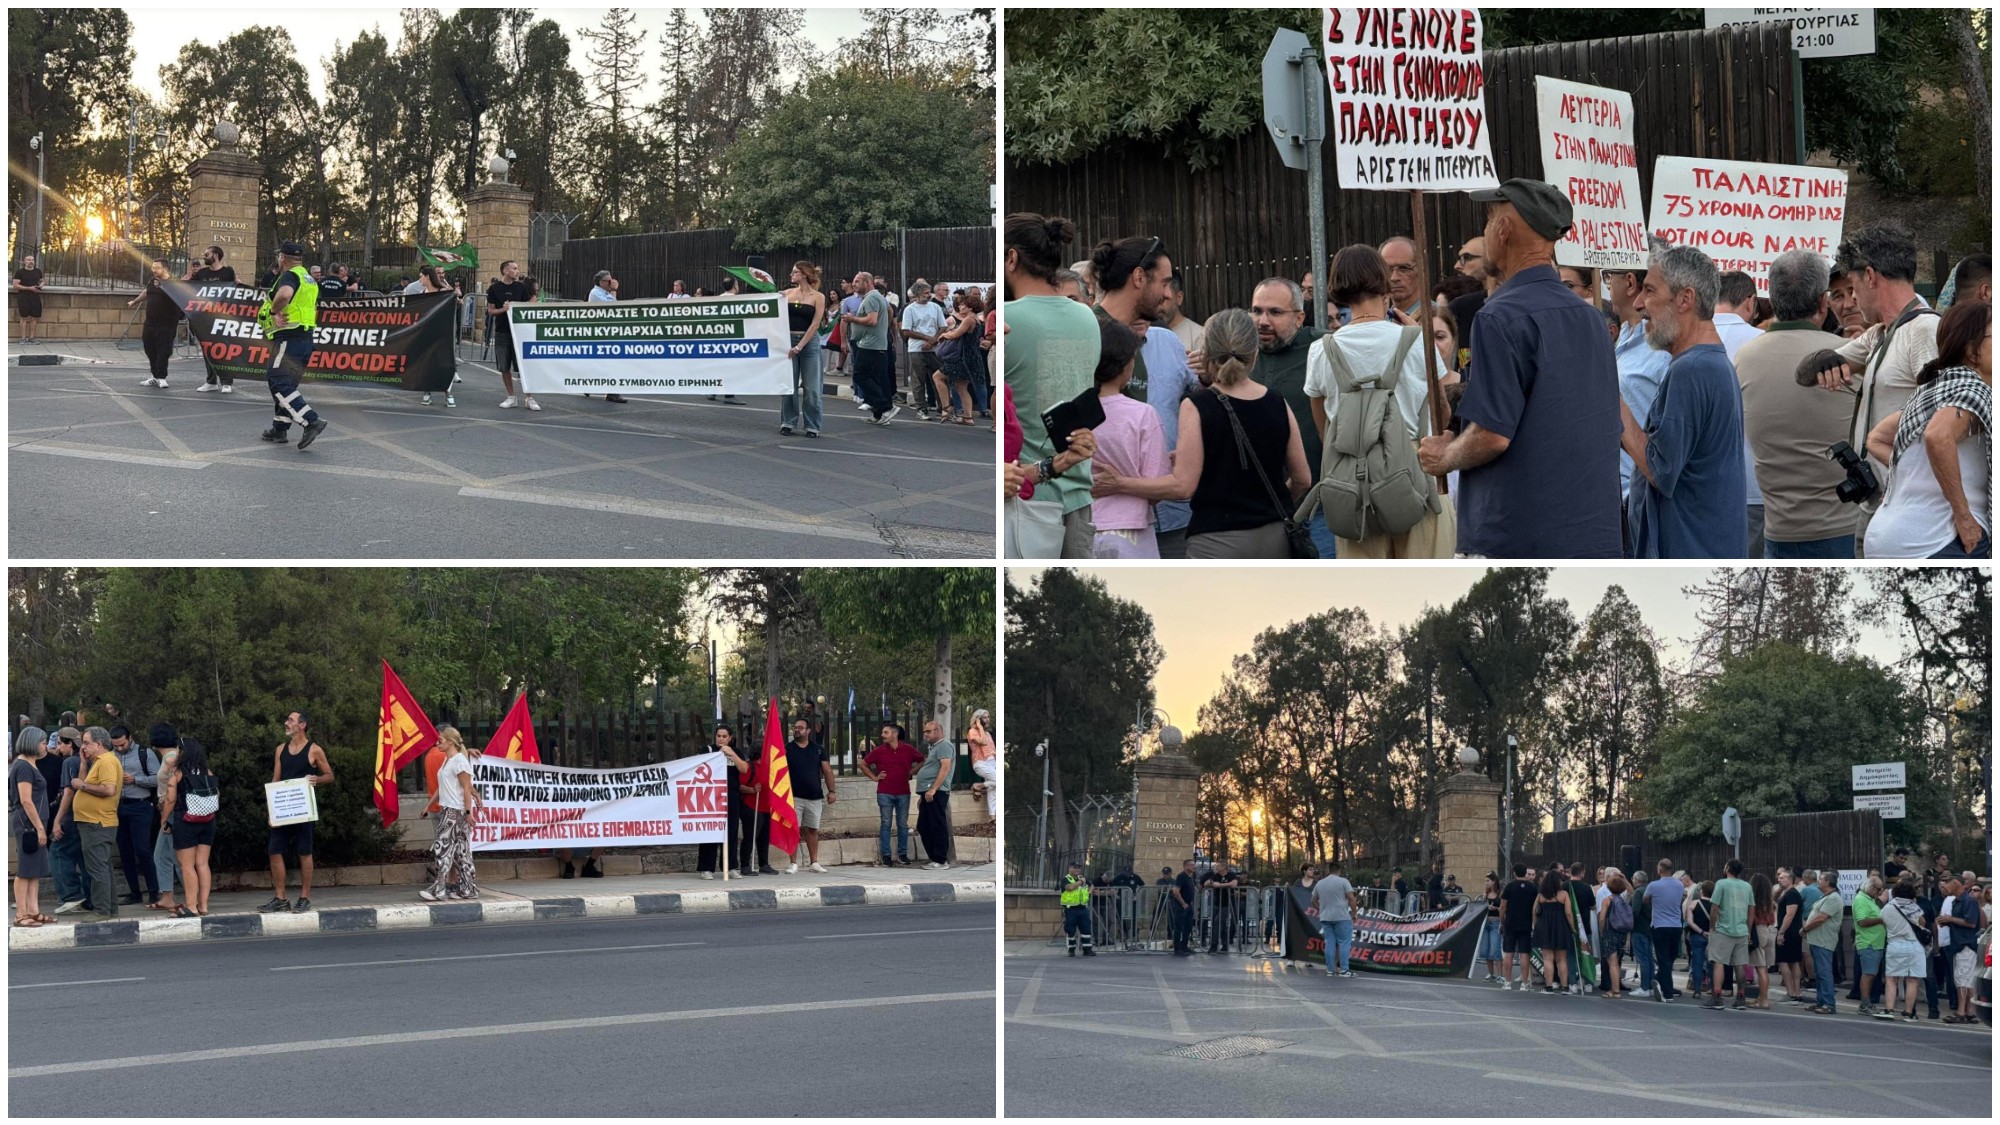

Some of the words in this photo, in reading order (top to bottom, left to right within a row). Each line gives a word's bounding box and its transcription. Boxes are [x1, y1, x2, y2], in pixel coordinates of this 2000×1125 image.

[1796, 34, 1834, 48] 21:00
[1330, 55, 1386, 95] ΣΤΗΝ
[1560, 93, 1622, 129] ΛΕΥΤΕΡΙΑ
[1340, 101, 1482, 149] ΠΑΡΑΙΤΗΣΟΥ
[1554, 132, 1587, 163] ΣΤΗΝ
[1357, 154, 1430, 184] ΑΡΙΣΤΕΡΗ
[1436, 154, 1495, 179] ΠΤΕΡΥΓΑ
[1569, 177, 1626, 209] FREEDOM
[1663, 194, 1694, 218] 75
[1698, 199, 1764, 220] ΧΡΟΝΙΑ
[1768, 204, 1842, 221] ΟΜΗΡΙΑΣ
[210, 220, 249, 230] ΕΙΣΟΔΟΣ
[1561, 221, 1580, 244] OR
[1581, 218, 1648, 252] PALESTINE
[1689, 229, 1709, 247] IN
[1711, 229, 1754, 249] OUR
[196, 286, 268, 301] ΛΕΥΤΕΡΙΑ
[317, 297, 405, 309] ΑΛΑΙΣΤΙΝΗ!
[184, 300, 259, 317] ΣΤΑΜΑΤΗ
[321, 310, 419, 326] ΓΕΝΟΚΤΟΝΙΑ!
[520, 308, 638, 319] ΥΠΕΡΑΣΠΙΖΟΜΑΣΤΕ
[641, 307, 659, 317] ΤΟ
[660, 305, 719, 317] ΔΙΕΘΝΕΣ
[720, 303, 769, 315] ΔΙΚΑΙΟ
[210, 318, 264, 340] FREE
[312, 327, 388, 347] ESTINE!
[544, 327, 565, 337] ΚΑΙ
[566, 327, 592, 336] ΤΗΝ
[594, 325, 664, 336] ΚΥΡΙΑΡΧΙΑ
[665, 325, 693, 335] ΤΩΝ
[695, 324, 735, 335] ΛΑΩΝ
[200, 341, 242, 361] TOP
[248, 346, 271, 364] TH
[307, 351, 407, 373] ENOCIDE!
[529, 345, 593, 355] ΑΠΕΝΑΝΤΙ
[596, 345, 621, 355] ΣΤΟ
[624, 345, 665, 355] ΝΟΜΟ
[668, 344, 695, 354] ΤΟΥ
[698, 343, 759, 354] ΙΣΧΥΡΟΥ
[564, 378, 617, 386] ΠΑΓΚΥΠΡΙΟ
[619, 378, 675, 387] ΣΥΜΒΟΥΛΙΟ
[678, 379, 723, 387] ΕΙΡΗΝΗΣ
[473, 764, 513, 783] ΚΑΜΙΑ
[514, 768, 560, 785] ΣΤΗΡΙΞΗ
[561, 773, 599, 785] ΚΑΜΙΑ
[602, 767, 670, 785] ΣΥΝΕΡΓΑΣΙΑ
[492, 785, 506, 801] ΤΟ
[508, 785, 550, 802] ΚΡΑΤΟΣ
[552, 786, 612, 803] ΔΟΛΟΦΟΝΟ
[472, 806, 518, 824] ΚΑΜΙΑ
[472, 826, 498, 843] ΣΤΙΣ
[500, 821, 600, 841] ΙΜΠΕΡΙΑΛΙΣΤΙΚΕΣ
[602, 820, 673, 837] ΕΠΕΜΒΑΣΕΙΣ
[682, 822, 693, 832] ΚΟ
[1146, 822, 1185, 830] ΕΙΣΟΔΟΣ
[1359, 930, 1442, 947] PALESTINE!
[1350, 946, 1372, 960] HE
[1373, 949, 1453, 966] GENOCIDE!
